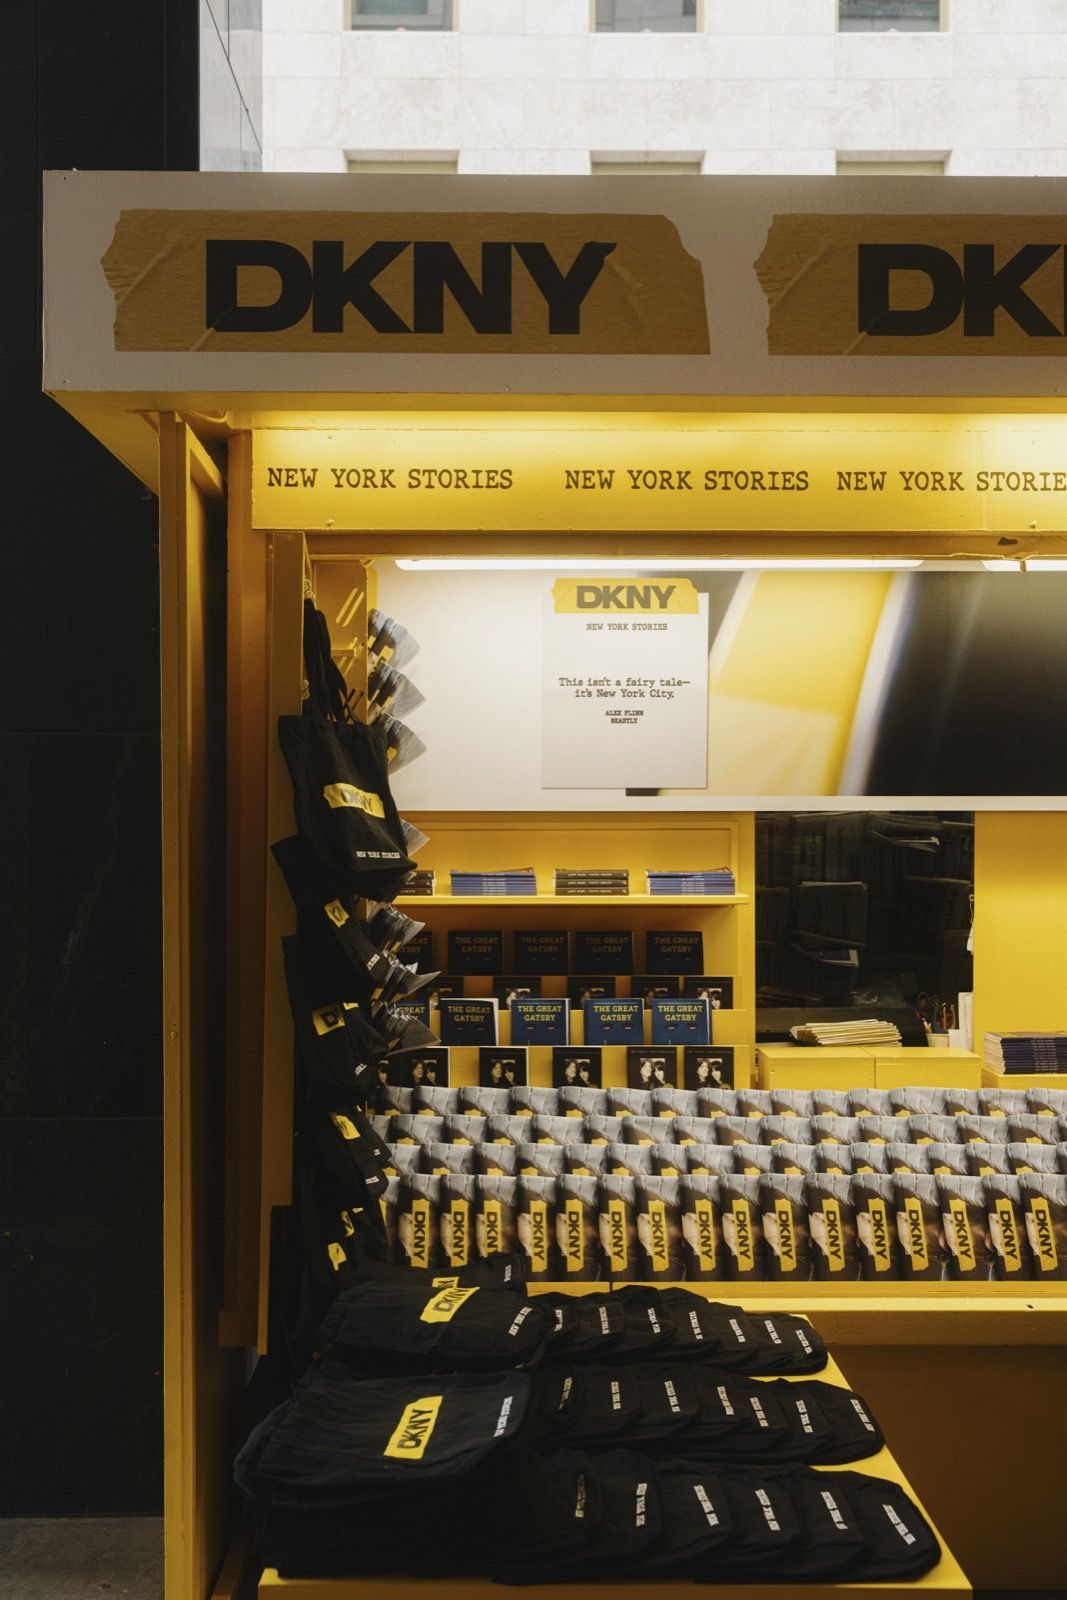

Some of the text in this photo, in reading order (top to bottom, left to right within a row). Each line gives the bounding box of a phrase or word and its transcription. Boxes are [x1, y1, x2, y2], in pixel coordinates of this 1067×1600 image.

[206, 239, 617, 335] DKNY
[858, 243, 1067, 337] DK
[267, 467, 513, 490] NEW YORK STORIES
[564, 469, 809, 491] NEW YORK STORIES
[837, 471, 887, 491] NEW
[899, 471, 964, 491] YORK
[576, 585, 677, 609] DKNY
[586, 623, 668, 631] NEW YORK STORIES
[558, 677, 583, 687] This
[615, 679, 622, 687] a
[625, 677, 656, 689] fairy
[596, 689, 616, 698] New
[620, 689, 645, 698] York
[413, 1210, 426, 1262] DKNY
[452, 1210, 465, 1261] DKNY
[487, 1211, 499, 1248] DKN
[532, 1211, 546, 1262] DKNY
[568, 1210, 581, 1261] DKNY
[611, 1210, 624, 1260] DKNY
[651, 1210, 667, 1261] DKNY
[699, 1210, 713, 1260] DKNY
[735, 1209, 751, 1260] DKNY
[778, 1209, 794, 1260] DKNY
[825, 1209, 841, 1260] DKNY
[872, 1209, 887, 1260] DKNY
[908, 1209, 924, 1259] DKNY
[953, 1210, 973, 1260] DKNY
[999, 1209, 1018, 1260] DKNY
[1035, 1209, 1052, 1259] DKNY
[396, 1409, 433, 1450] DKNY
